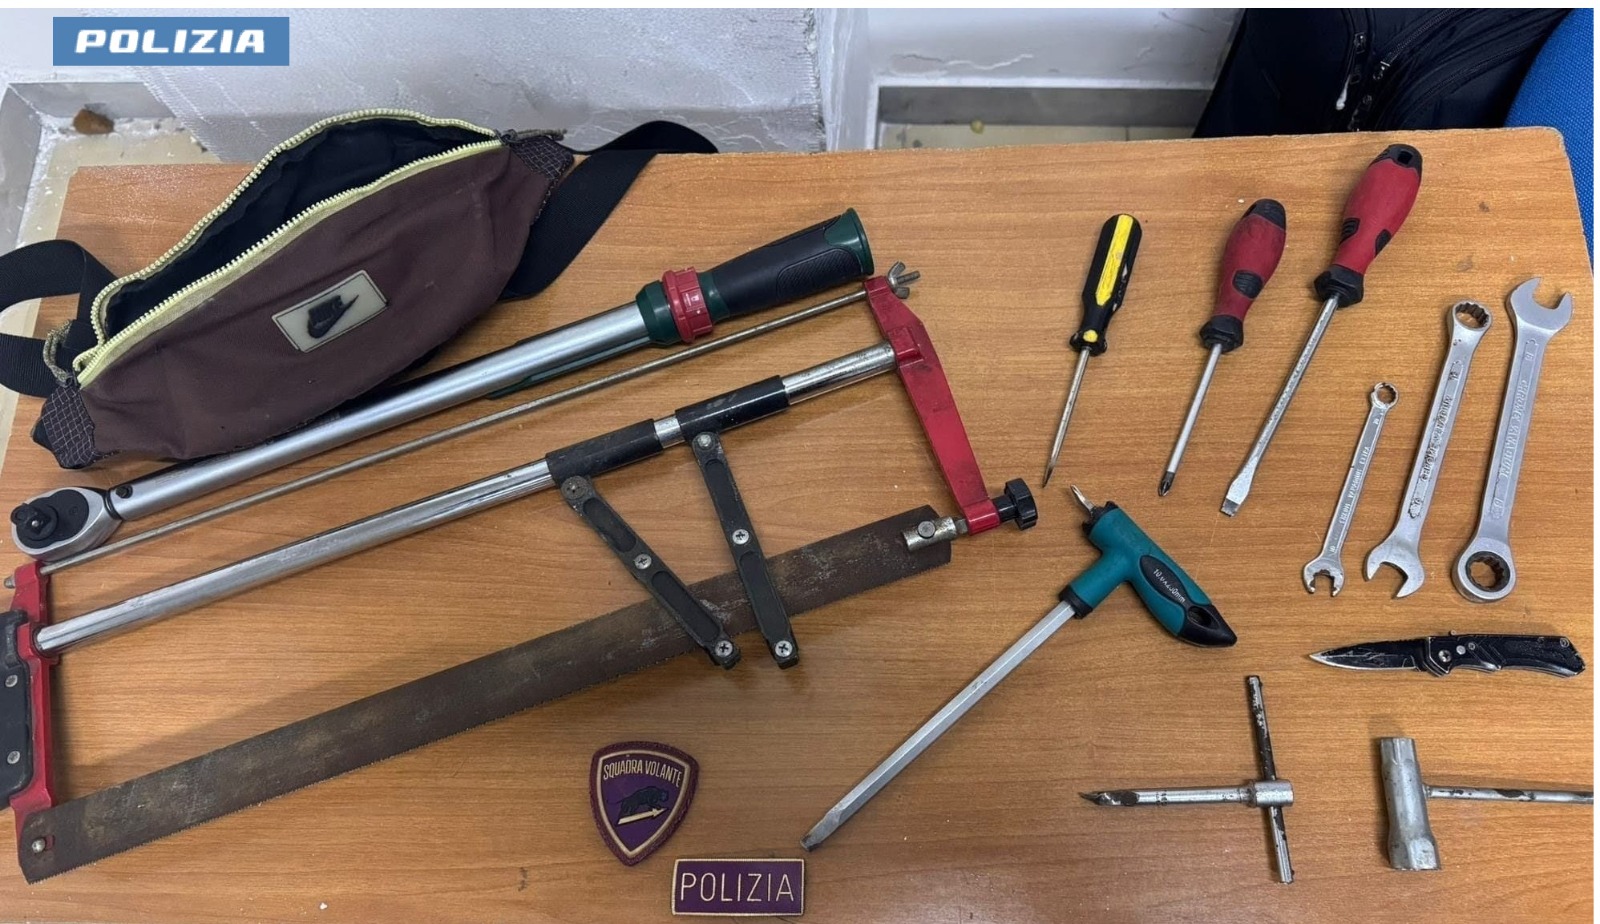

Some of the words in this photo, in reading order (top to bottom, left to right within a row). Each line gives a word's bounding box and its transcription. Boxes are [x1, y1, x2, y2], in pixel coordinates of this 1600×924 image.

[1419, 443, 1439, 482] CHROME
[603, 759, 643, 781] SQUADRA
[645, 760, 682, 788] VOLANTE
[680, 872, 794, 902] POLIZIA
